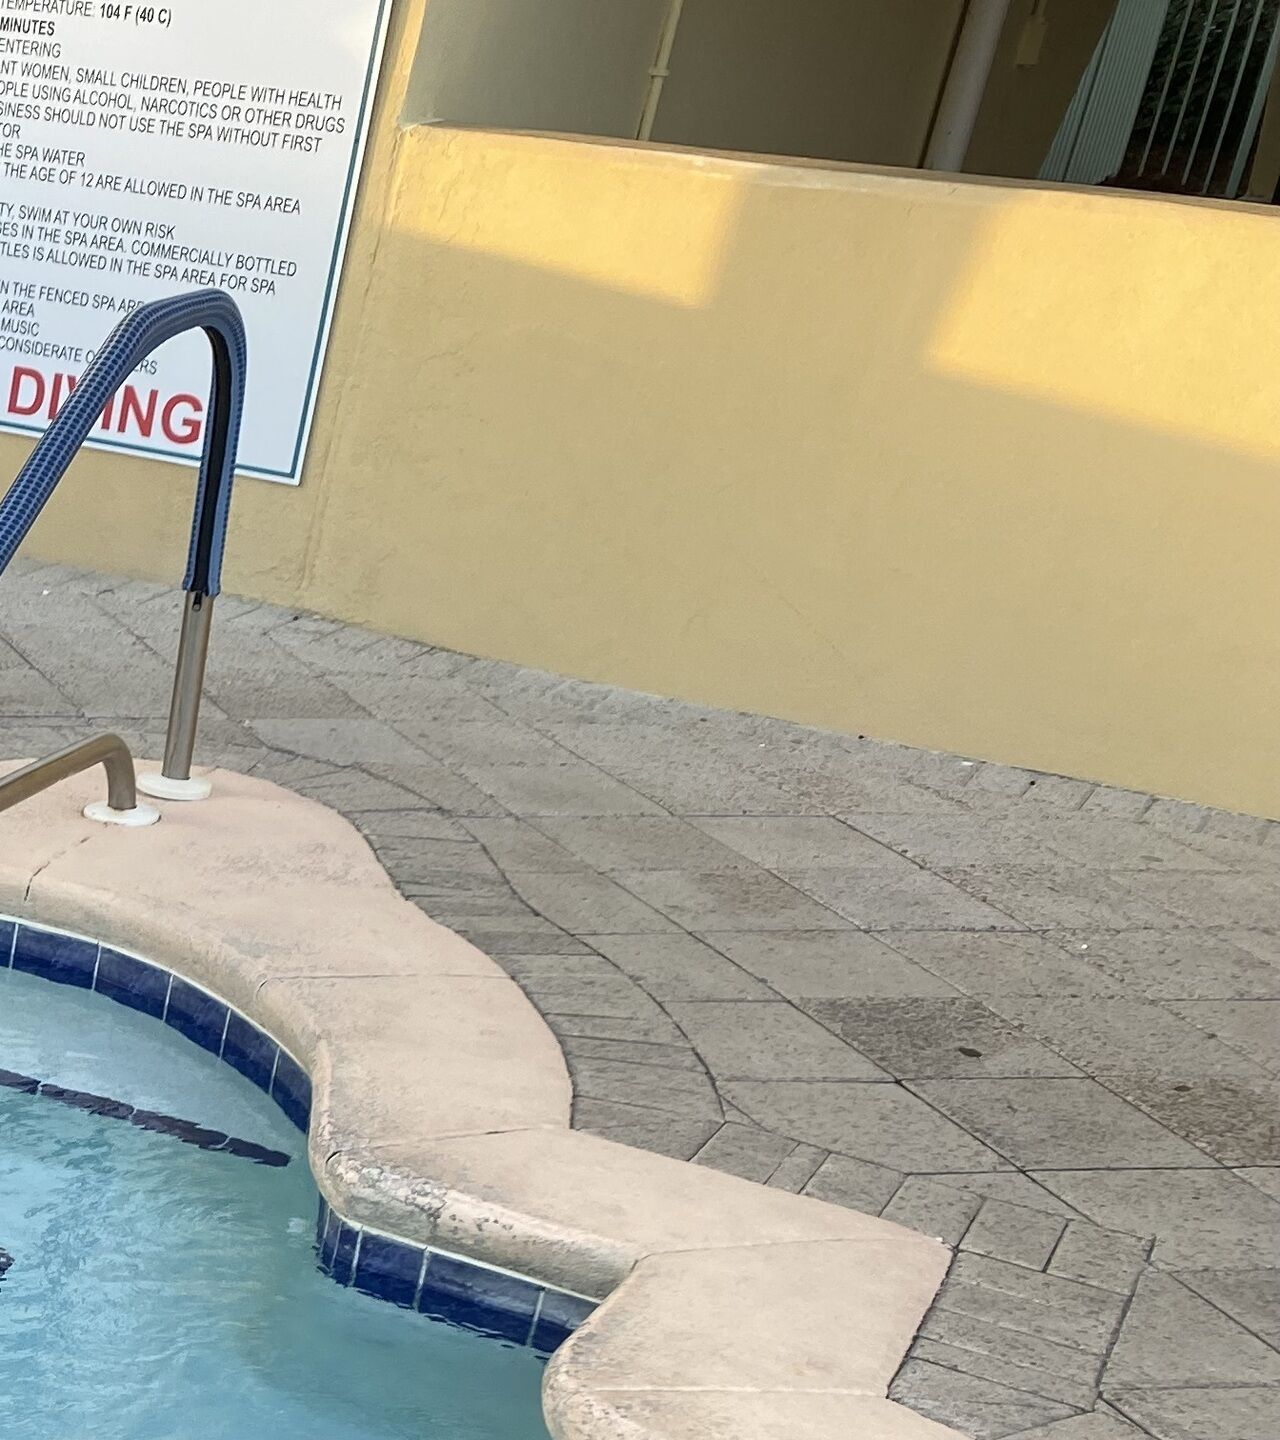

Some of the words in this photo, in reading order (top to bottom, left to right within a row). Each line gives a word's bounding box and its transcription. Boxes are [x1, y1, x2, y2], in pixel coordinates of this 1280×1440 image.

[0, 16, 55, 36] MINUTES
[100, 3, 121, 19] 104
[124, 5, 133, 21] F
[135, 6, 154, 27] (40
[158, 8, 172, 28] C)
[21, 62, 70, 83] WOMEN,
[75, 67, 116, 86] SMALL
[120, 72, 188, 95] CHILDREN,
[192, 79, 247, 100] PEOPLE
[251, 86, 285, 104] WITH
[288, 90, 342, 110] HEALTH
[31, 84, 70, 102] USING
[72, 88, 136, 112] ALCOHOL,
[140, 96, 217, 119] NARCOTICS
[221, 104, 241, 121] OR
[244, 107, 292, 127] OTHER
[294, 113, 345, 133] DRUGS
[43, 106, 95, 126] SHOULD
[98, 112, 127, 129] NOT
[128, 116, 155, 133] USE
[159, 119, 185, 137] THE
[187, 122, 212, 140] SPA
[216, 125, 279, 147] WITHOUT
[281, 133, 322, 152] FIRST
[15, 144, 38, 160] SPA
[42, 147, 85, 167] WATER
[3, 161, 27, 179] THE
[28, 165, 56, 183] AGE
[58, 168, 77, 185] OF
[80, 171, 94, 187] 12
[94, 173, 122, 191] ARE
[124, 177, 187, 199] ALLOWED
[189, 185, 204, 201] IN
[207, 187, 233, 205] THE
[235, 191, 261, 209] SPA
[263, 195, 300, 214] AREA
[18, 204, 52, 222] SWIM
[52, 209, 70, 225] AT
[72, 211, 108, 230] YOUR
[110, 217, 142, 235] OWN
[144, 221, 175, 240] RISK
[21, 224, 34, 239] IN
[37, 226, 61, 243] THE
[63, 229, 87, 247] SPA
[88, 233, 126, 253] AREA.
[130, 239, 234, 268] COMMERCIALLY
[235, 253, 297, 276] BOTTLED
[32, 245, 44, 261] IS
[45, 247, 107, 270] ALLOWED
[109, 256, 123, 273] IN
[126, 258, 151, 277] THE
[153, 263, 178, 281] SPA
[179, 267, 215, 288] AREA
[218, 272, 247, 291] FOR
[249, 277, 275, 296] SPA
[0, 298, 34, 317] AREA
[13, 281, 36, 299] THE
[38, 285, 89, 307] FENCED
[91, 293, 115, 312] SPA
[118, 298, 144, 313] AR
[0, 316, 39, 336] MUSIC
[86, 349, 96, 364] O
[8, 365, 204, 445] DIING
